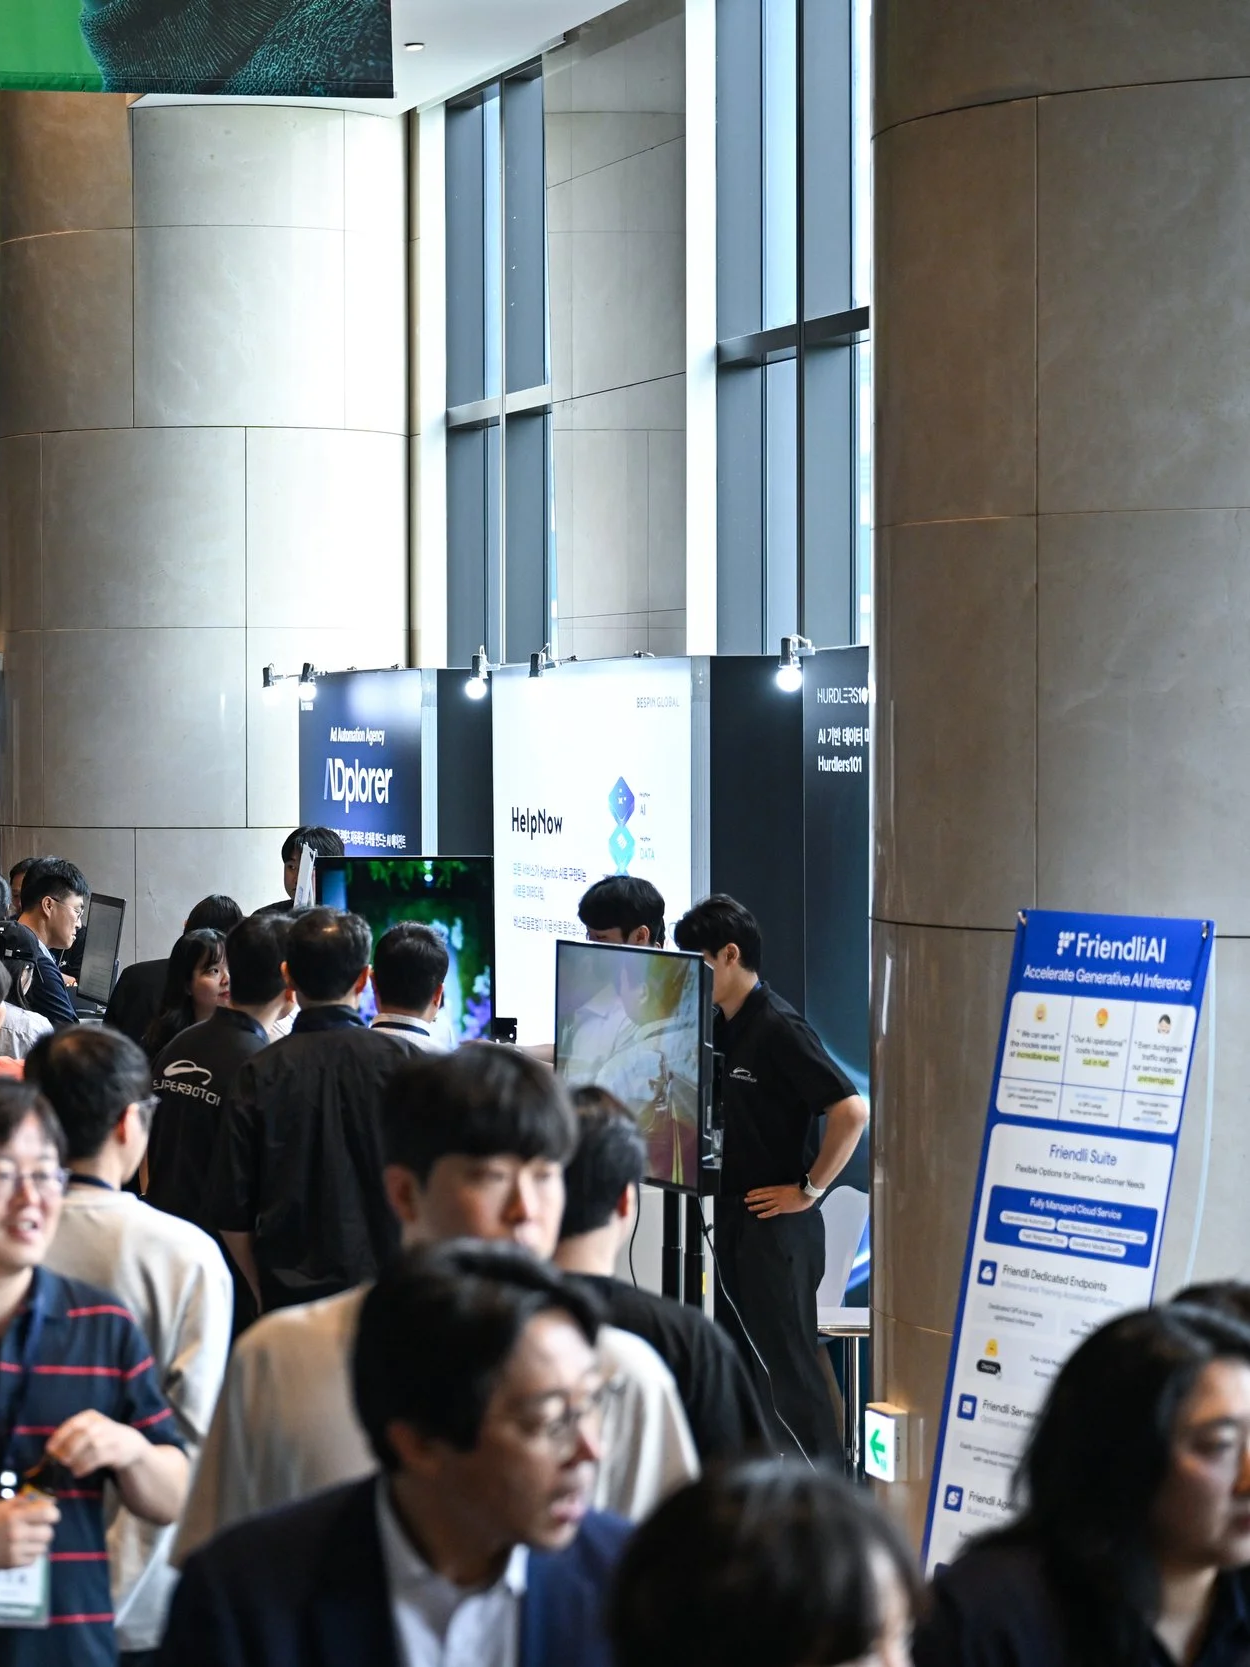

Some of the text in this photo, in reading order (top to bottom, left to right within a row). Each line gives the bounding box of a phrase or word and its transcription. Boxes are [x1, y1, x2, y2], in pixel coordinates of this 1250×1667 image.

[636, 696, 680, 708] BESPIN GLOBAL
[330, 727, 337, 742] Ad
[366, 727, 385, 746] Agency
[818, 728, 826, 744] AI
[843, 726, 863, 747] 데이터
[818, 755, 862, 773] Hurdlers101
[324, 758, 393, 813] ADplorer
[511, 806, 563, 840] HelpNow
[1075, 932, 1167, 964] FriendliAI
[1023, 964, 1192, 992] Accelerate Generative AI Inference
[1049, 1143, 1117, 1166] Friendli Suite
[1015, 1162, 1145, 1189] Flexible Options for Diverse Customer Needs
[1030, 1197, 1122, 1221] Fully Managed Cloud Service
[1002, 1264, 1108, 1293] Friendli Dedicated Endpoints
[982, 1399, 1009, 1414] Friendli
[968, 1490, 996, 1506] Friendli
